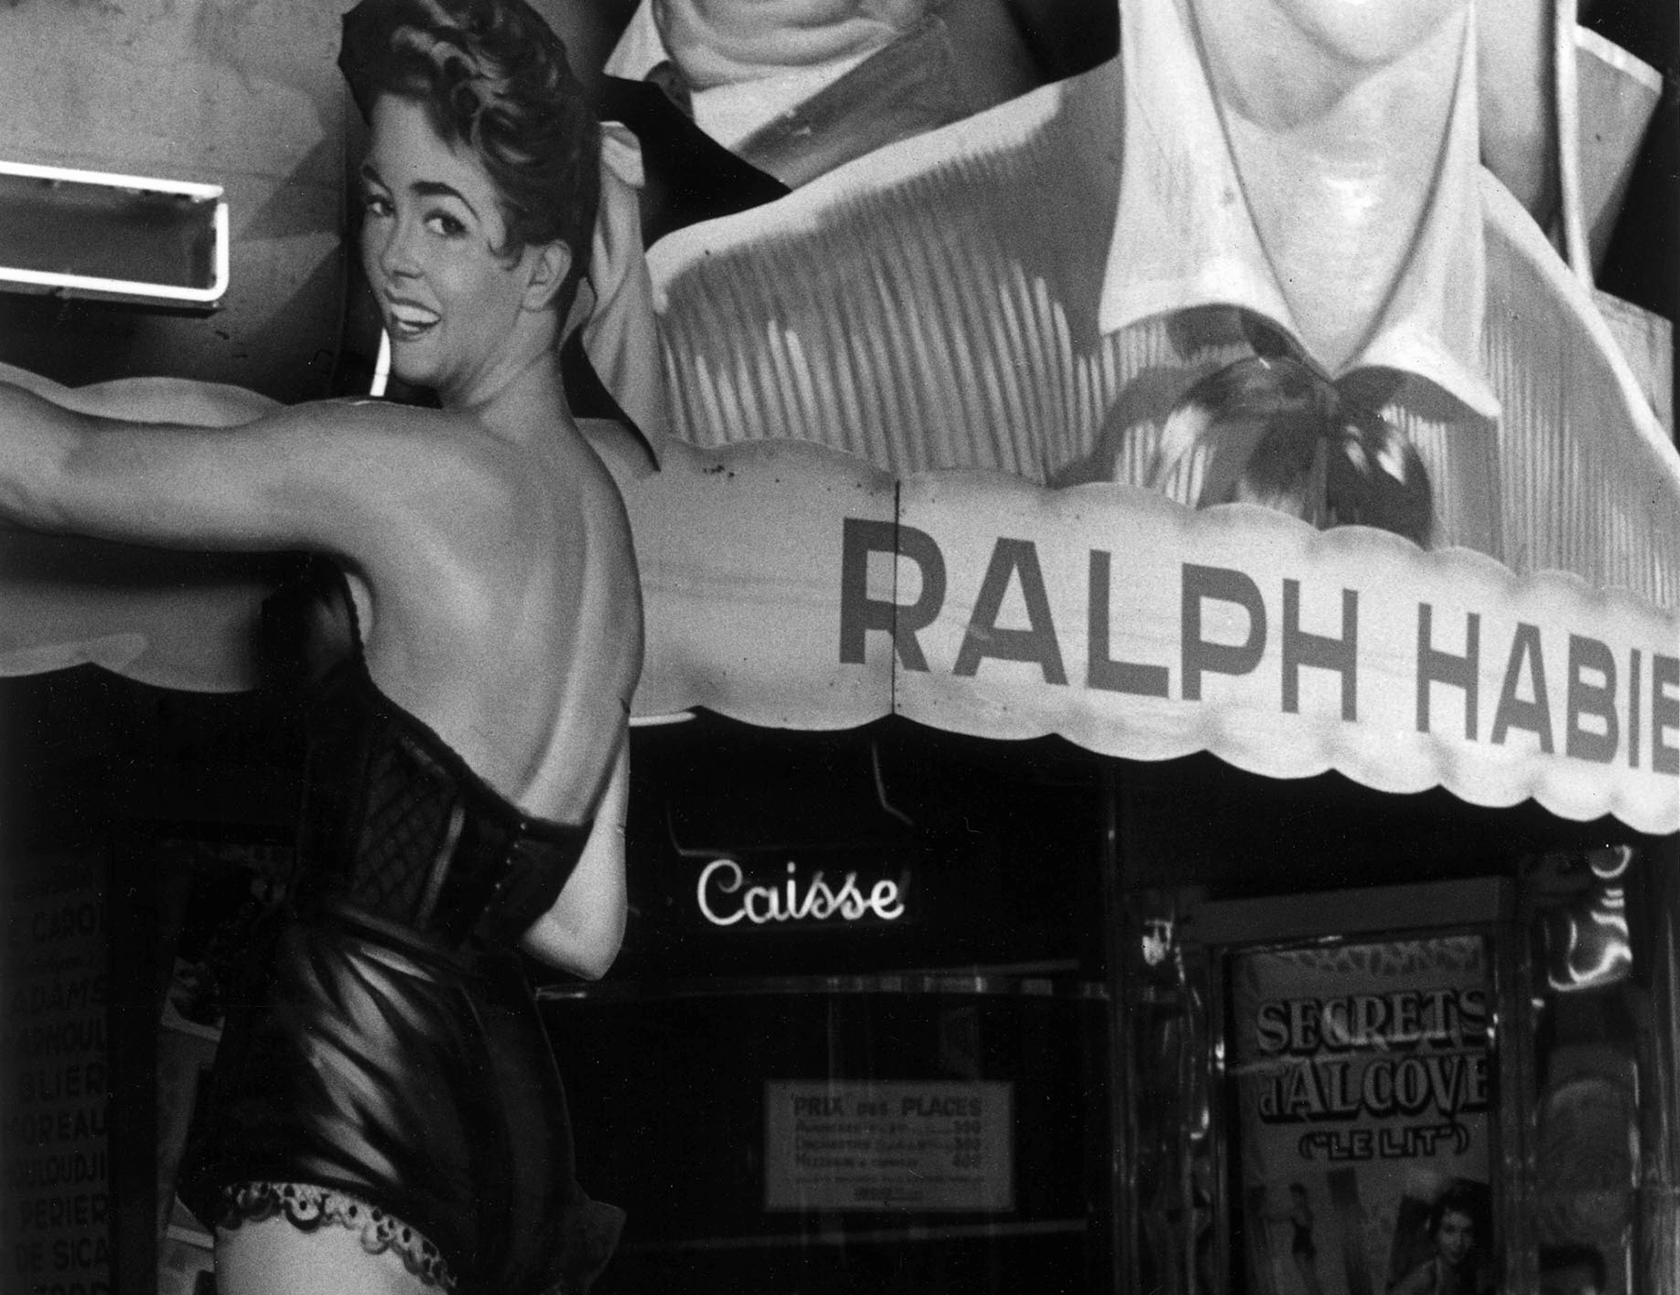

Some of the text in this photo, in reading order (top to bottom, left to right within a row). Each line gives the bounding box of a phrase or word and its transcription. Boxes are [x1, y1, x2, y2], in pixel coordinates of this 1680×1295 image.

[839, 516, 1680, 776] RALPH HABIE
[696, 858, 905, 926] Caisse
[1256, 990, 1487, 1053] SECRETS
[901, 1096, 982, 1117] PLACES
